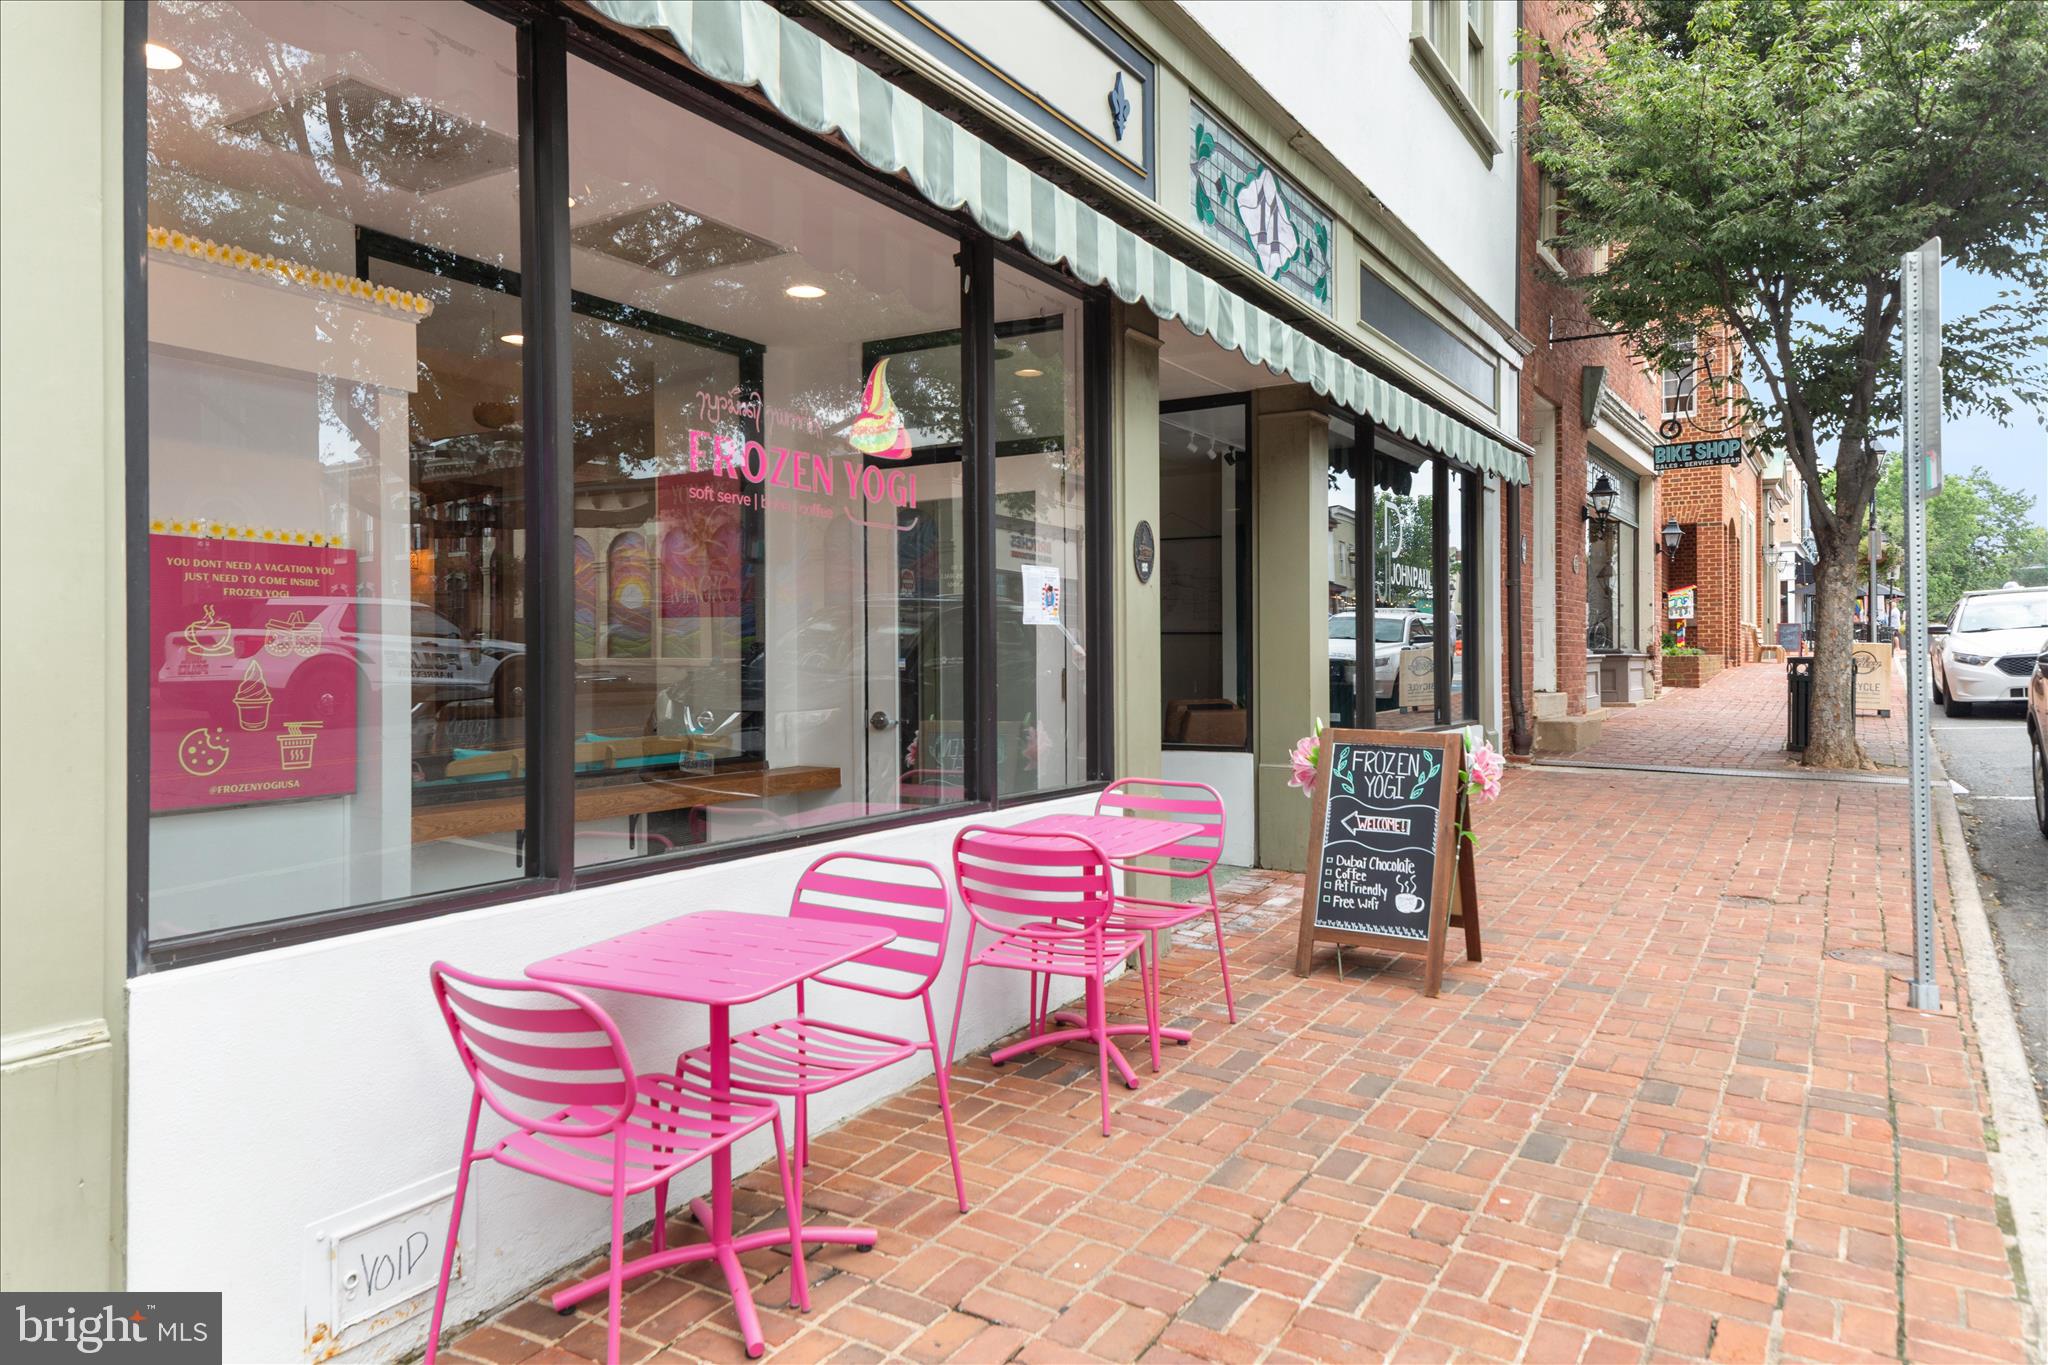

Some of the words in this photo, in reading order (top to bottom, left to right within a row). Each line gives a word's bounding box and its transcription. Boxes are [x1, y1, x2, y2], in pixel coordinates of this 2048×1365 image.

[1655, 444, 1692, 463] BIKE
[1695, 439, 1740, 460] SHOP
[688, 428, 834, 496] FROZEN
[841, 459, 918, 509] YOGI
[1685, 459, 1714, 468] SERVICE
[688, 485, 715, 501] soft
[717, 491, 752, 507] serve
[166, 557, 190, 567] YOU
[193, 558, 222, 568] DONT
[225, 560, 251, 570] NEED
[254, 562, 262, 571] A
[264, 563, 313, 574] VACATION
[315, 566, 336, 576] YOU
[1391, 562, 1433, 590] JOHNPAUL
[184, 572, 209, 582] JUST
[212, 573, 239, 583] NEED
[242, 575, 256, 584] TO
[259, 576, 288, 586] COME
[290, 578, 320, 587] INSIDE
[223, 587, 263, 597] FROZEN
[265, 588, 290, 598] YOGI
[1856, 682, 1880, 692] YCLE
[1352, 750, 1420, 777] FROZEN
[1364, 774, 1406, 799] YOGI
[1358, 818, 1406, 832] WELCOME!
[1336, 854, 1367, 869] Dubai
[1369, 856, 1415, 874] Chocolate
[1335, 868, 1367, 881] Coffee
[1334, 879, 1348, 892] Pet
[1350, 880, 1388, 902] Friendly
[1332, 895, 1355, 909] Free
[361, 1231, 429, 1297] VOID
